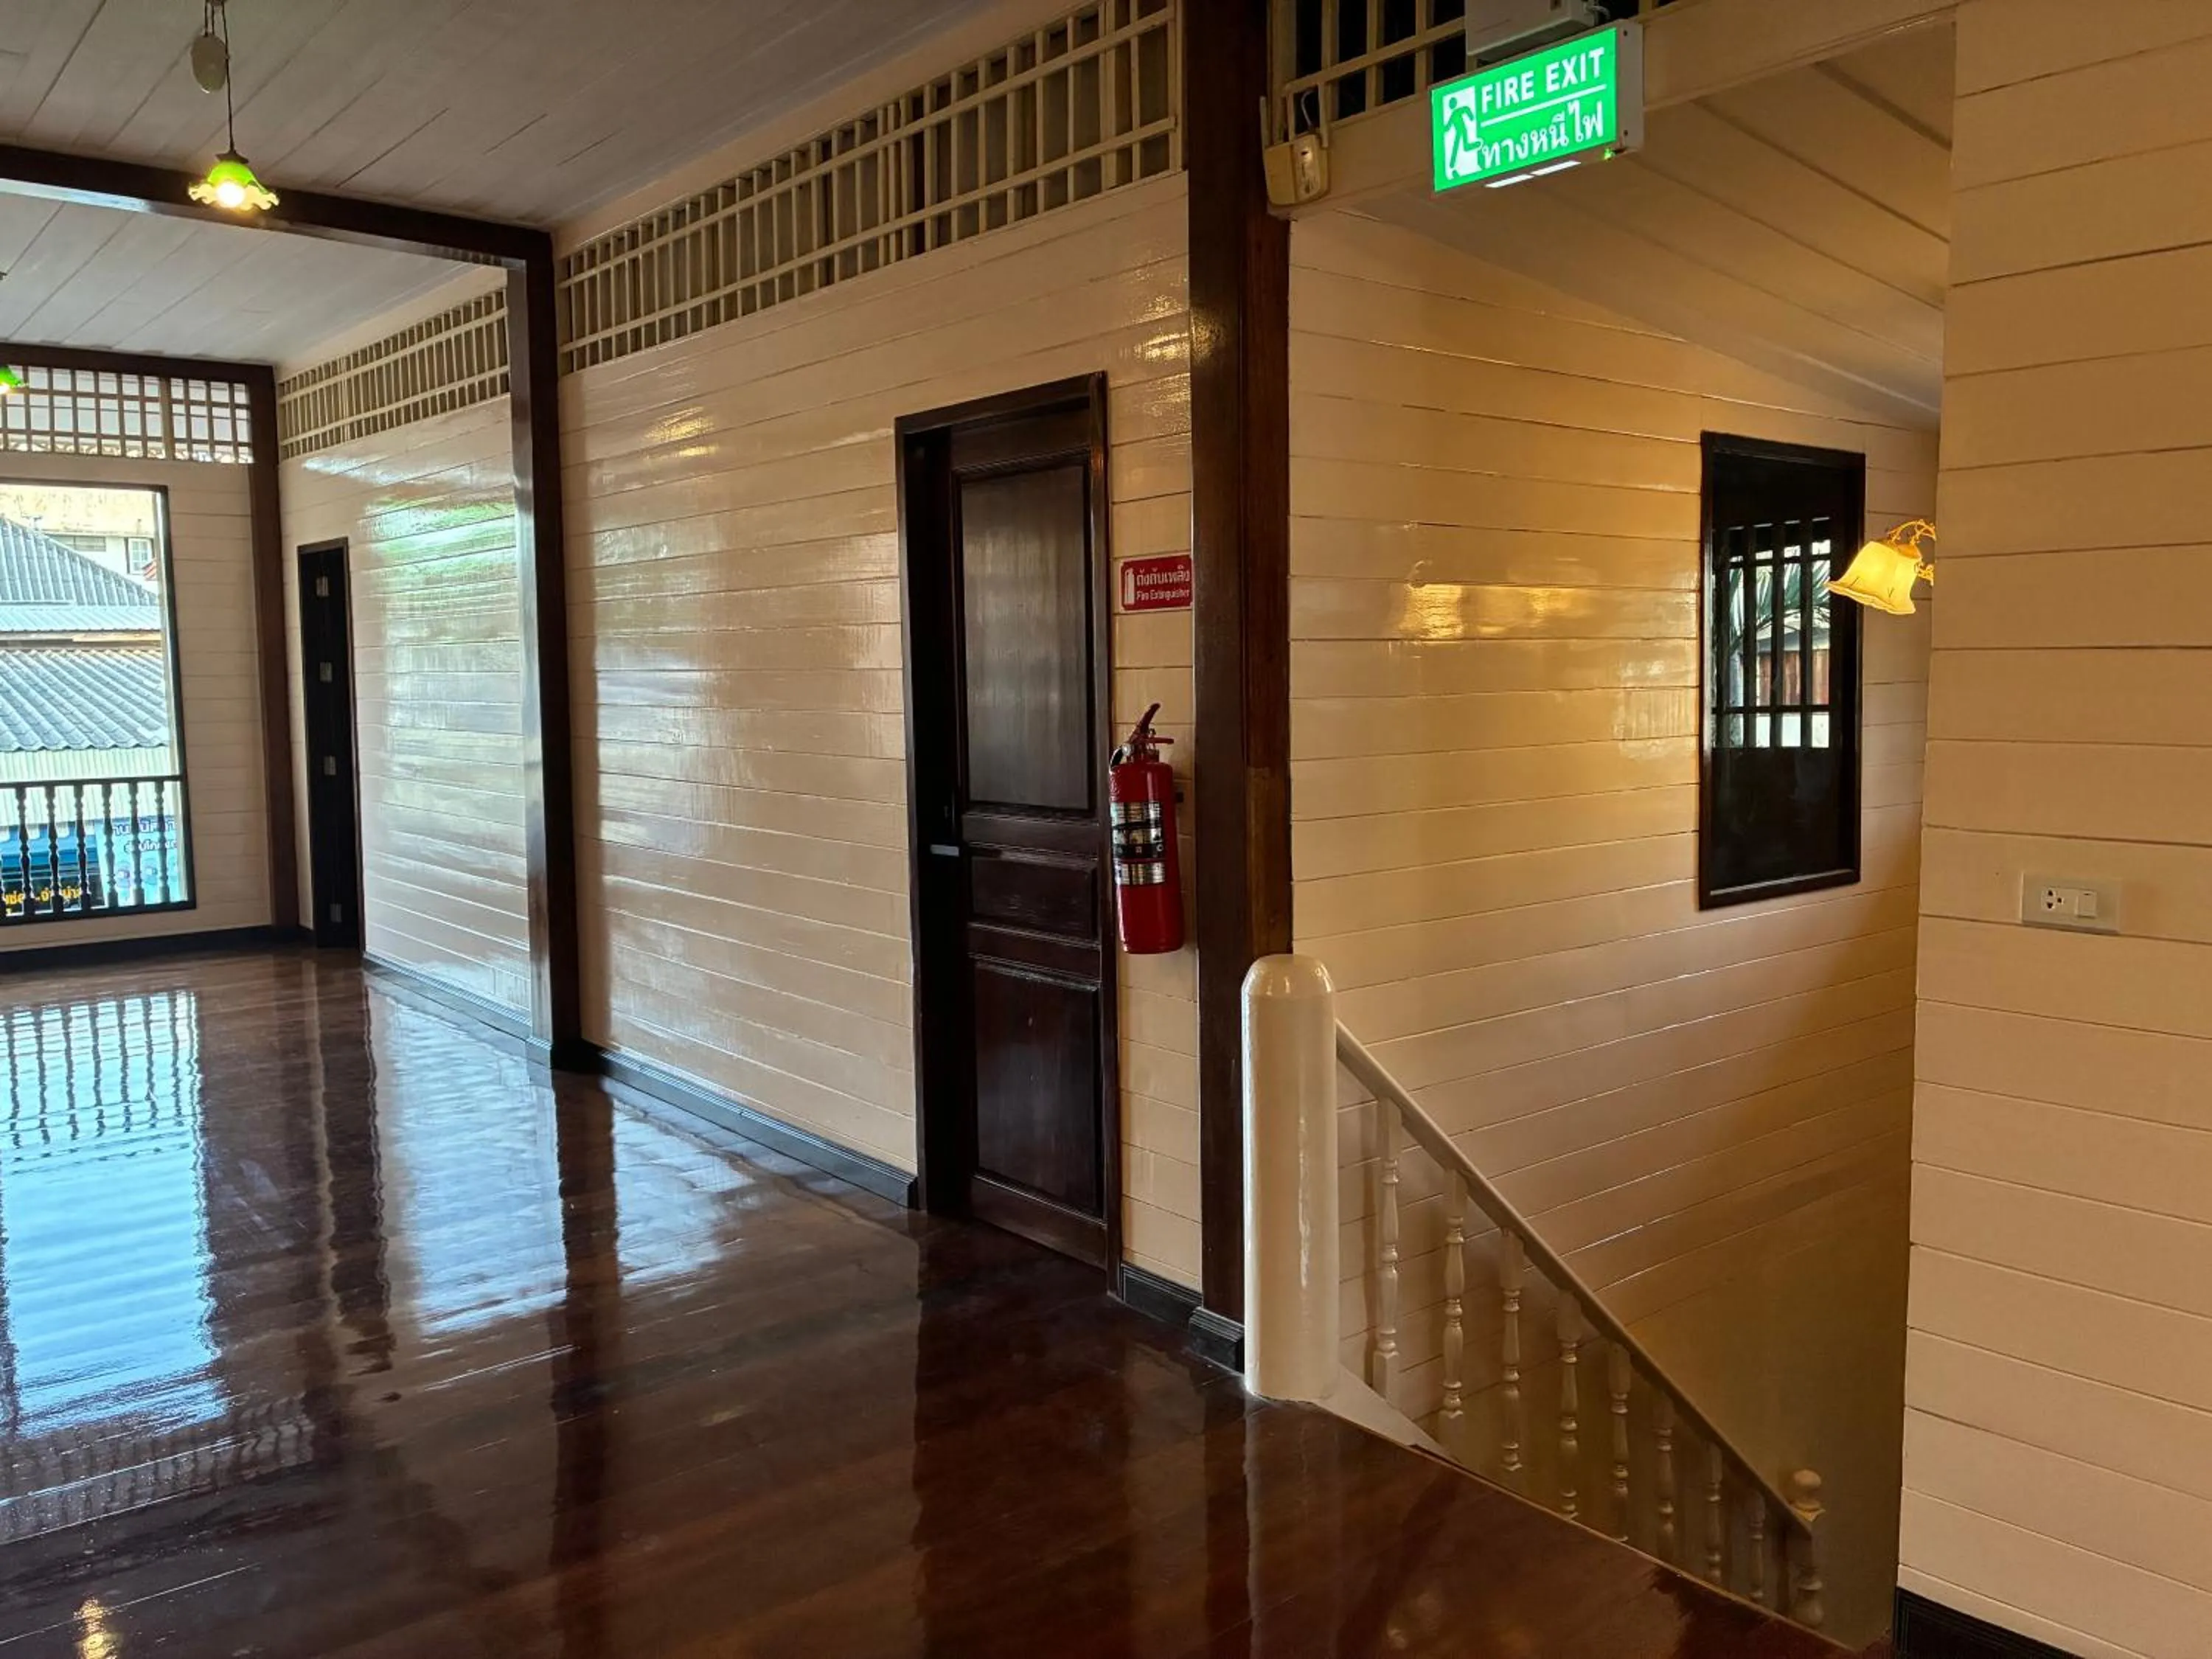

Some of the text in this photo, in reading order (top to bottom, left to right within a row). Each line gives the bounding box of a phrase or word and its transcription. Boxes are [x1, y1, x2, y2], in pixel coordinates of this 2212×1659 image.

[1481, 46, 1604, 114] FIRE EXIT
[1481, 100, 1604, 169] ทางหนีไฟ
[1136, 590, 1150, 601] Fire
